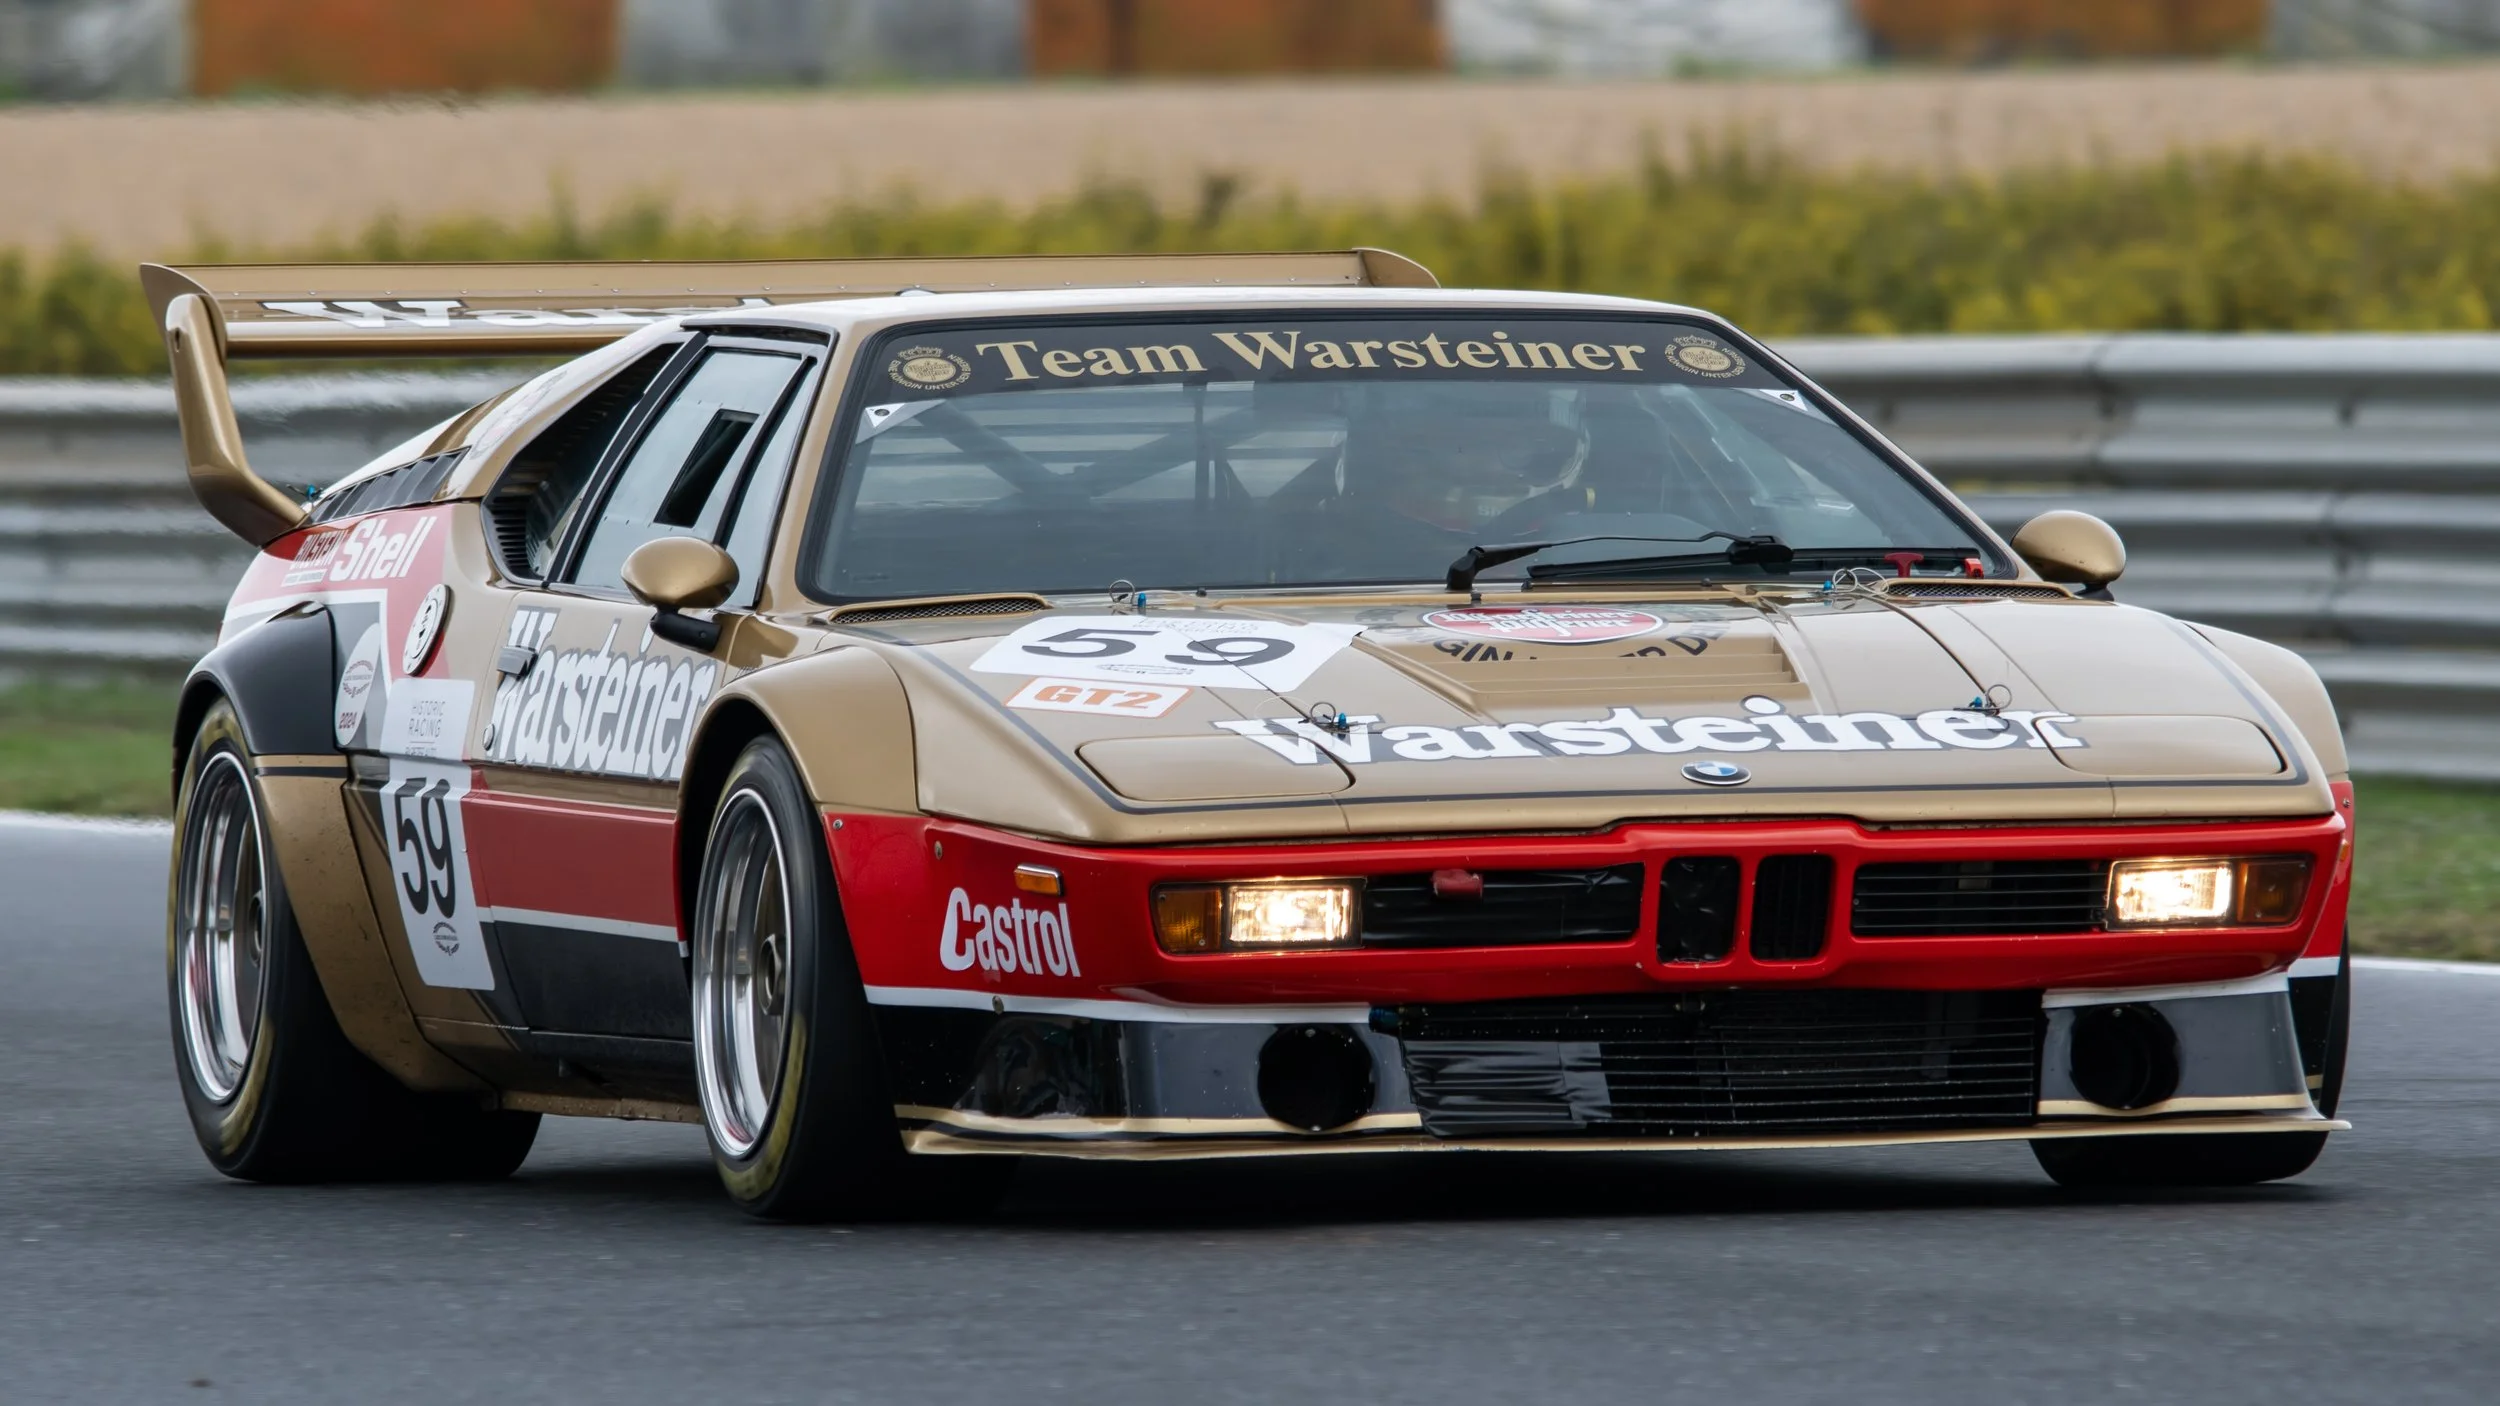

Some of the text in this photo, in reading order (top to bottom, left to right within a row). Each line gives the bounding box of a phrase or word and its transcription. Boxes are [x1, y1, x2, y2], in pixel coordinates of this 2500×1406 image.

[975, 340, 1208, 382] Team
[1211, 330, 1647, 372] Warsteiner
[329, 516, 437, 582] Shell
[1021, 628, 1296, 666] 59
[338, 711, 358, 730] 2024
[485, 606, 718, 780] Warsteiner
[1034, 685, 1164, 710] GT2
[408, 717, 442, 738] RACING
[1213, 696, 2088, 765] Warsteiner
[394, 777, 456, 919] 59
[940, 886, 1082, 978] Castrol
